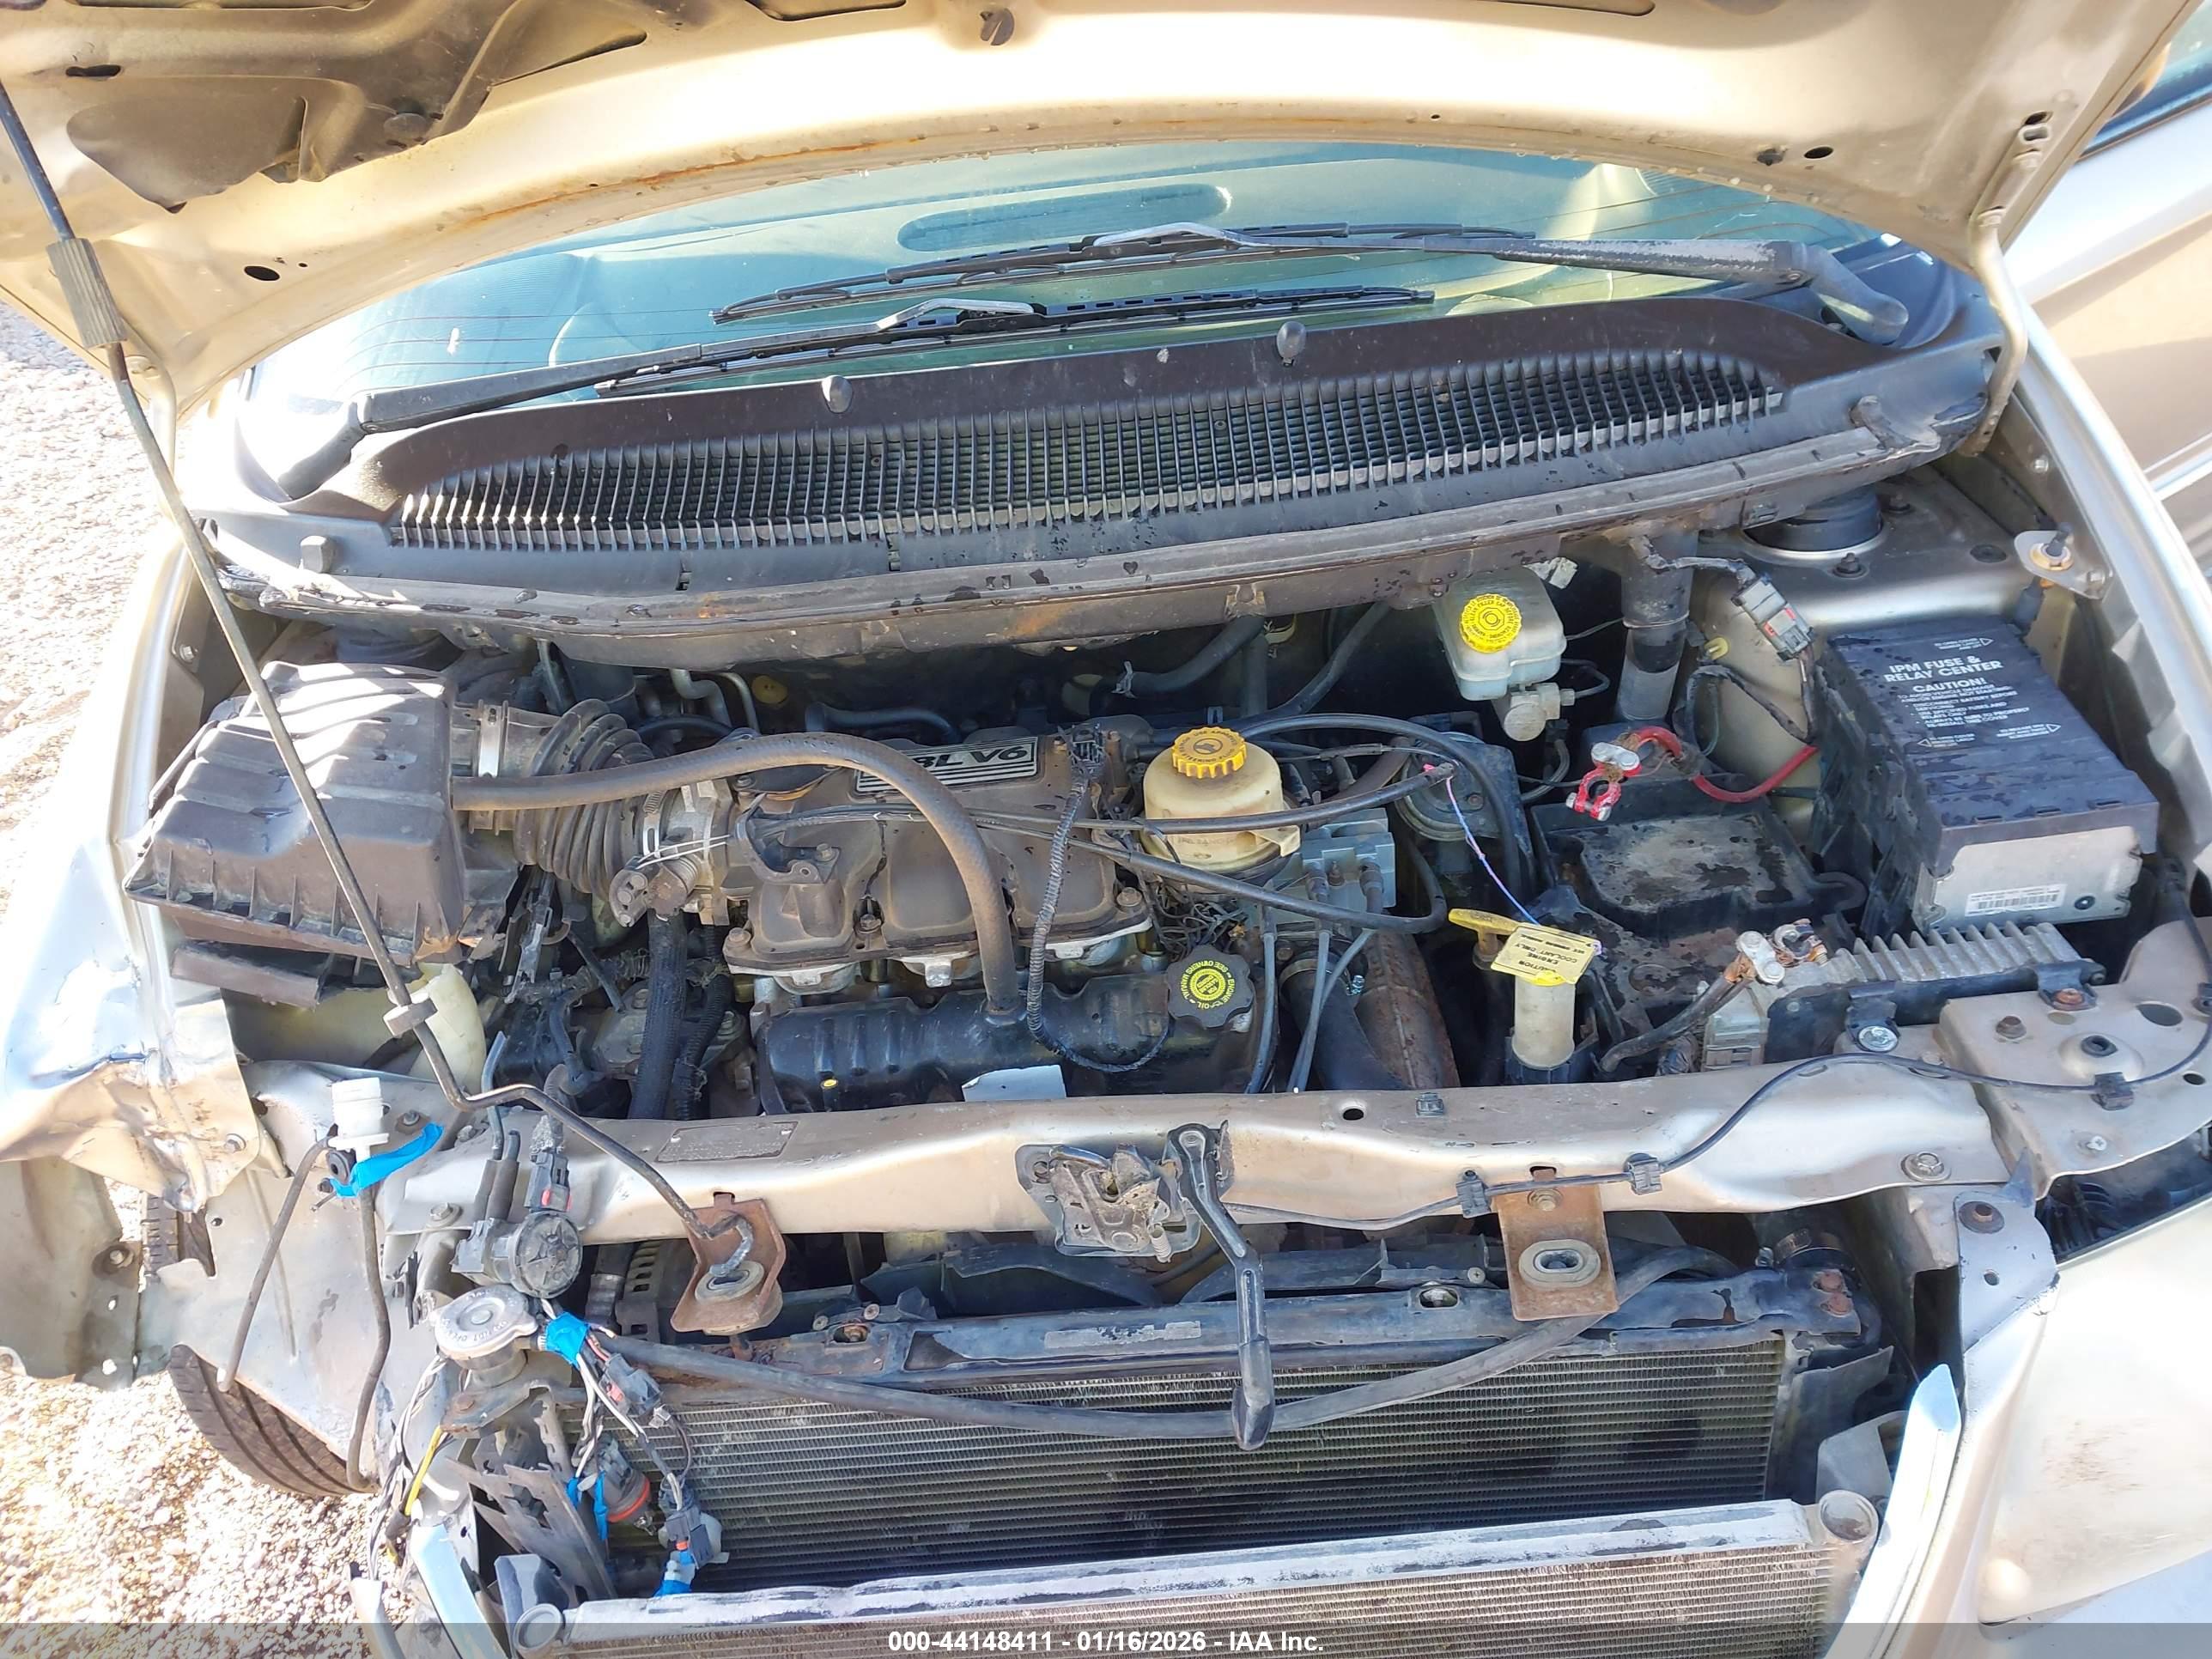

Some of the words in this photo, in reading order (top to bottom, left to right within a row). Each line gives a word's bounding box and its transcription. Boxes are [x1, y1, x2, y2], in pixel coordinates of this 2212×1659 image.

[1883, 671, 1933, 683] RELAY
[1938, 660, 2003, 676] CENTER
[1889, 663, 1921, 673] IPM
[1923, 657, 1964, 670] FUSE
[1967, 655, 1981, 664] &
[1913, 678, 1988, 693] CAUTION!
[970, 746, 1028, 763] V6
[1515, 943, 1536, 952] ONLY
[1527, 951, 1559, 965] ENGINE
[1540, 950, 1577, 963] COOLANT
[1186, 960, 1213, 975] OWNERS
[1213, 962, 1229, 973] SEE
[1518, 960, 1556, 973] UTION
[1181, 975, 1189, 1000] MANUAL
[1222, 979, 1235, 1004] ENGINE
